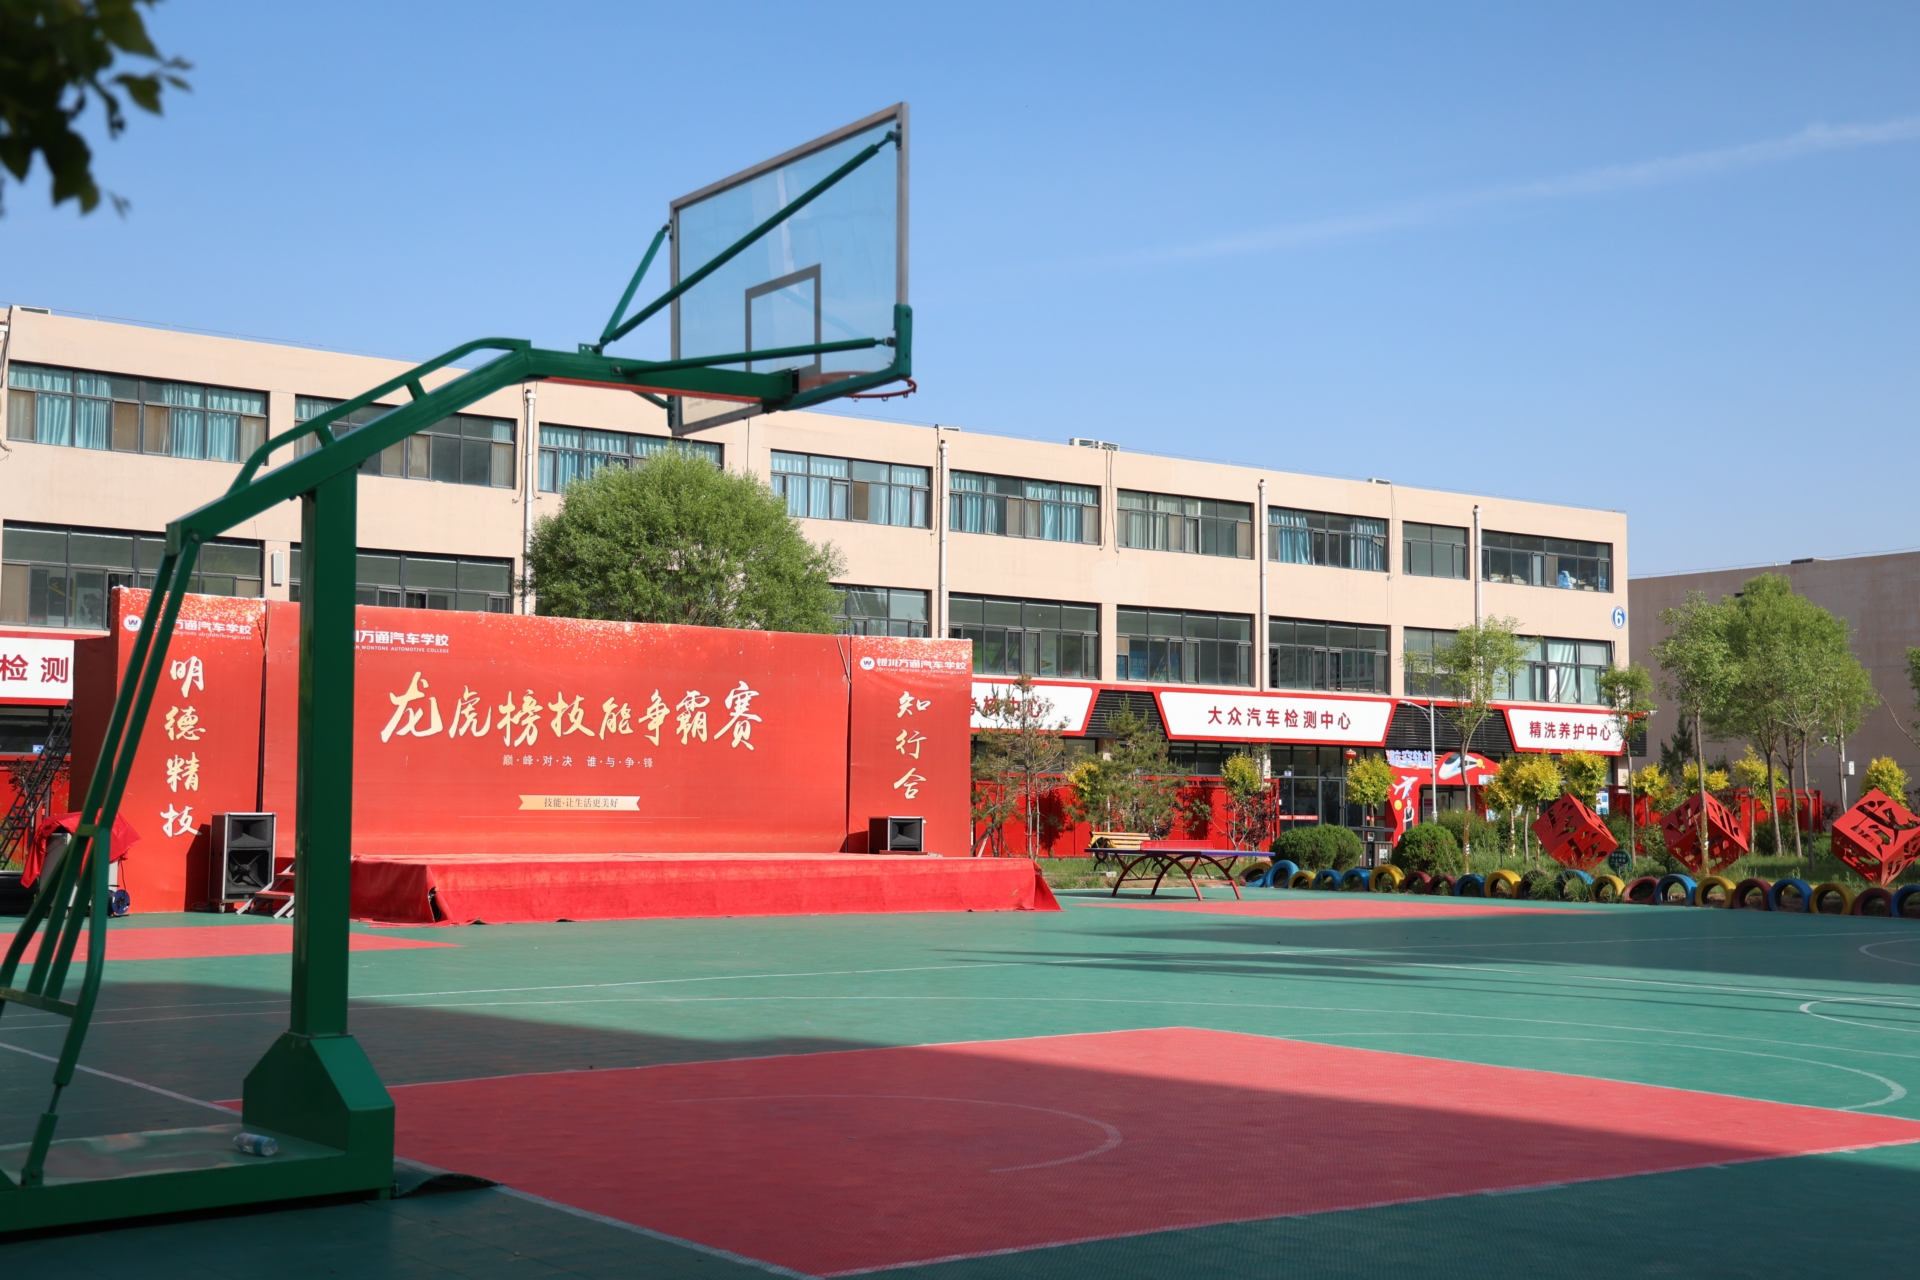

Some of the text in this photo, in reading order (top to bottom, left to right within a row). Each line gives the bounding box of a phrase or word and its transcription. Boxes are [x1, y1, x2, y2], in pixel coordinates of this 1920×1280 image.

[175, 619, 252, 635] 万通汽车学校
[1614, 609, 1623, 626] 6
[0, 654, 69, 683] 检测
[876, 657, 967, 670] 银川万通汽车学校
[381, 671, 763, 751] 龙虎榜技能争霸赛
[1207, 705, 1351, 730] 大众汽车检测中心
[1529, 720, 1611, 741] 精洗养护中心
[160, 656, 206, 838] 明德精技
[894, 690, 931, 800] 知行合
[544, 797, 619, 808] 技能·让生活更美好
